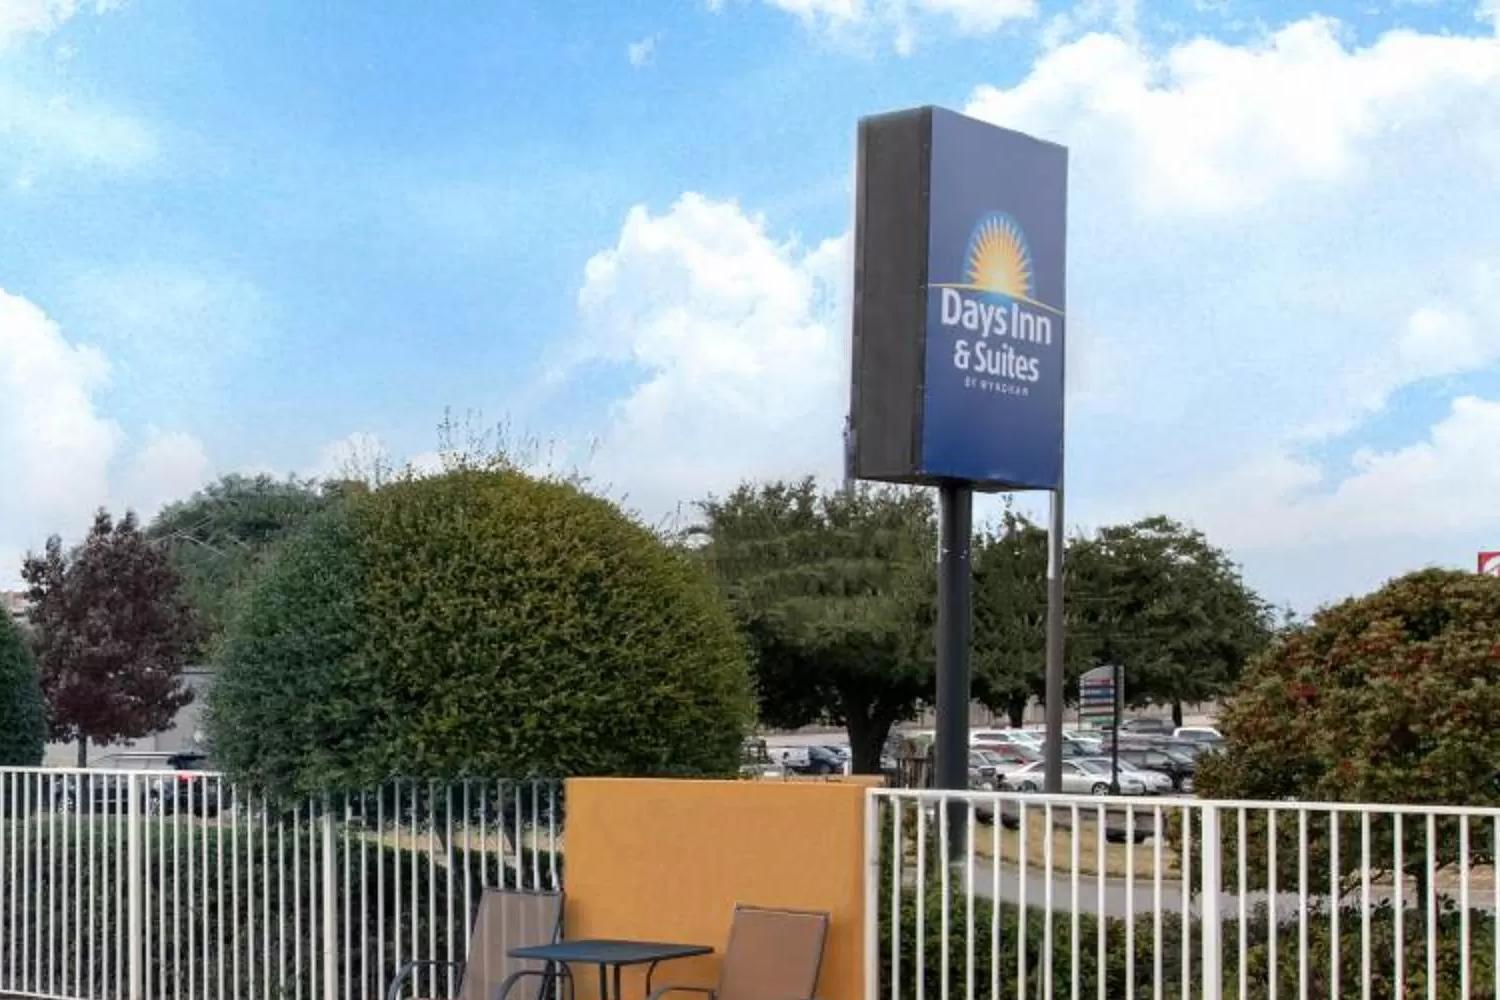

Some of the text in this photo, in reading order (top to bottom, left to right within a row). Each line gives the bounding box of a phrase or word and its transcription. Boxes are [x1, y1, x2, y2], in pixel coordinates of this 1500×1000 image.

[941, 287, 1051, 344] Days Inn
[953, 339, 1040, 382] & Suites
